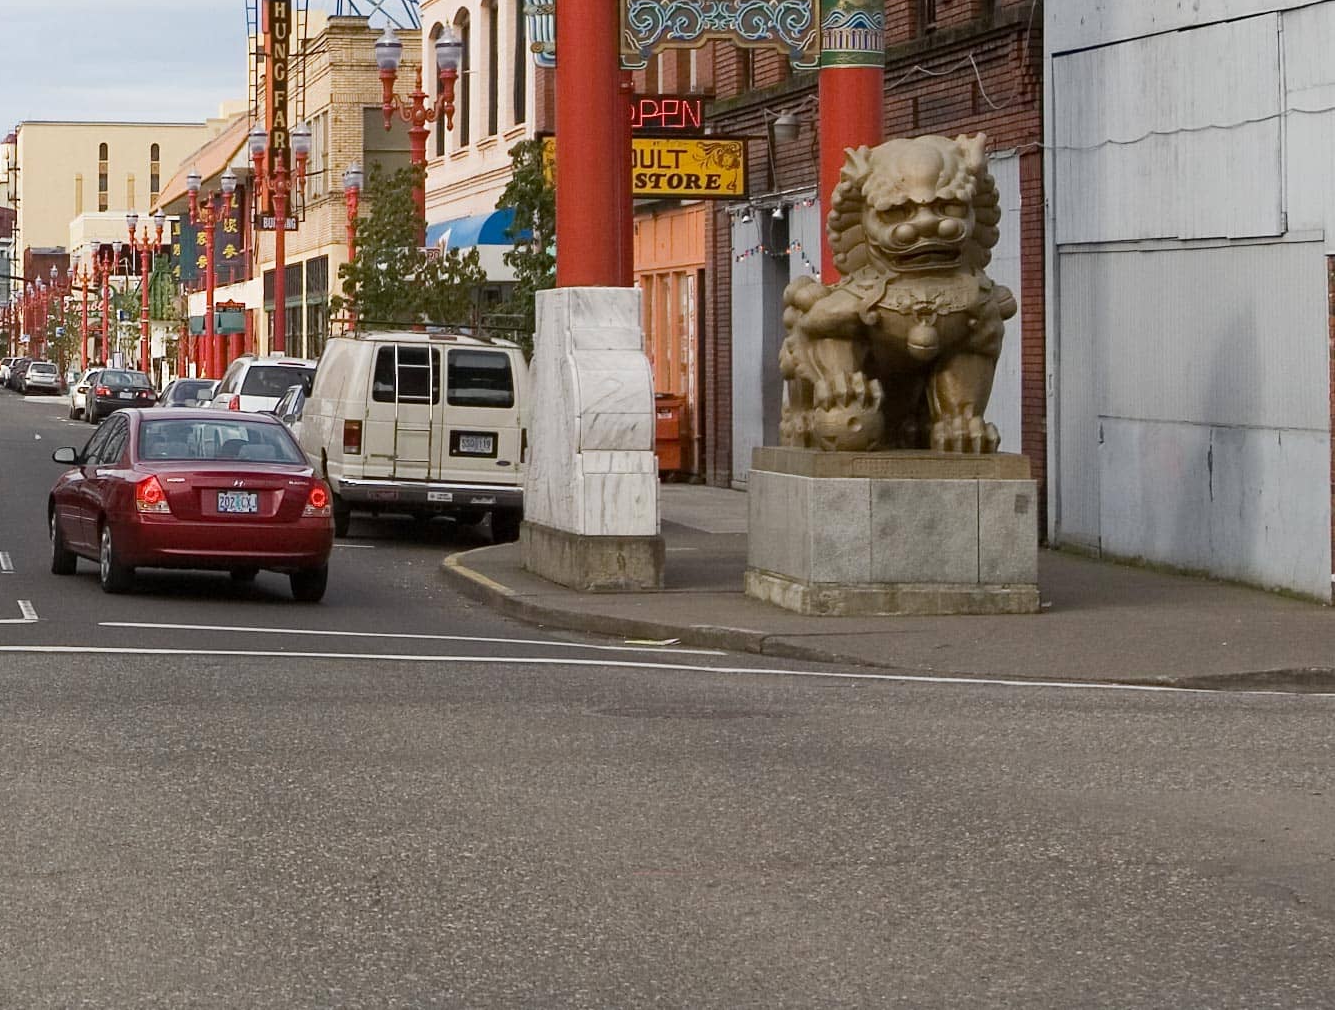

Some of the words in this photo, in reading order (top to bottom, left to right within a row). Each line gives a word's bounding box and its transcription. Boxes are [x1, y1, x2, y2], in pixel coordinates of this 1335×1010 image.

[274, 1, 286, 82] HUNG
[273, 91, 286, 149] FAR
[631, 99, 700, 127] PEN
[635, 173, 721, 189] STORE
